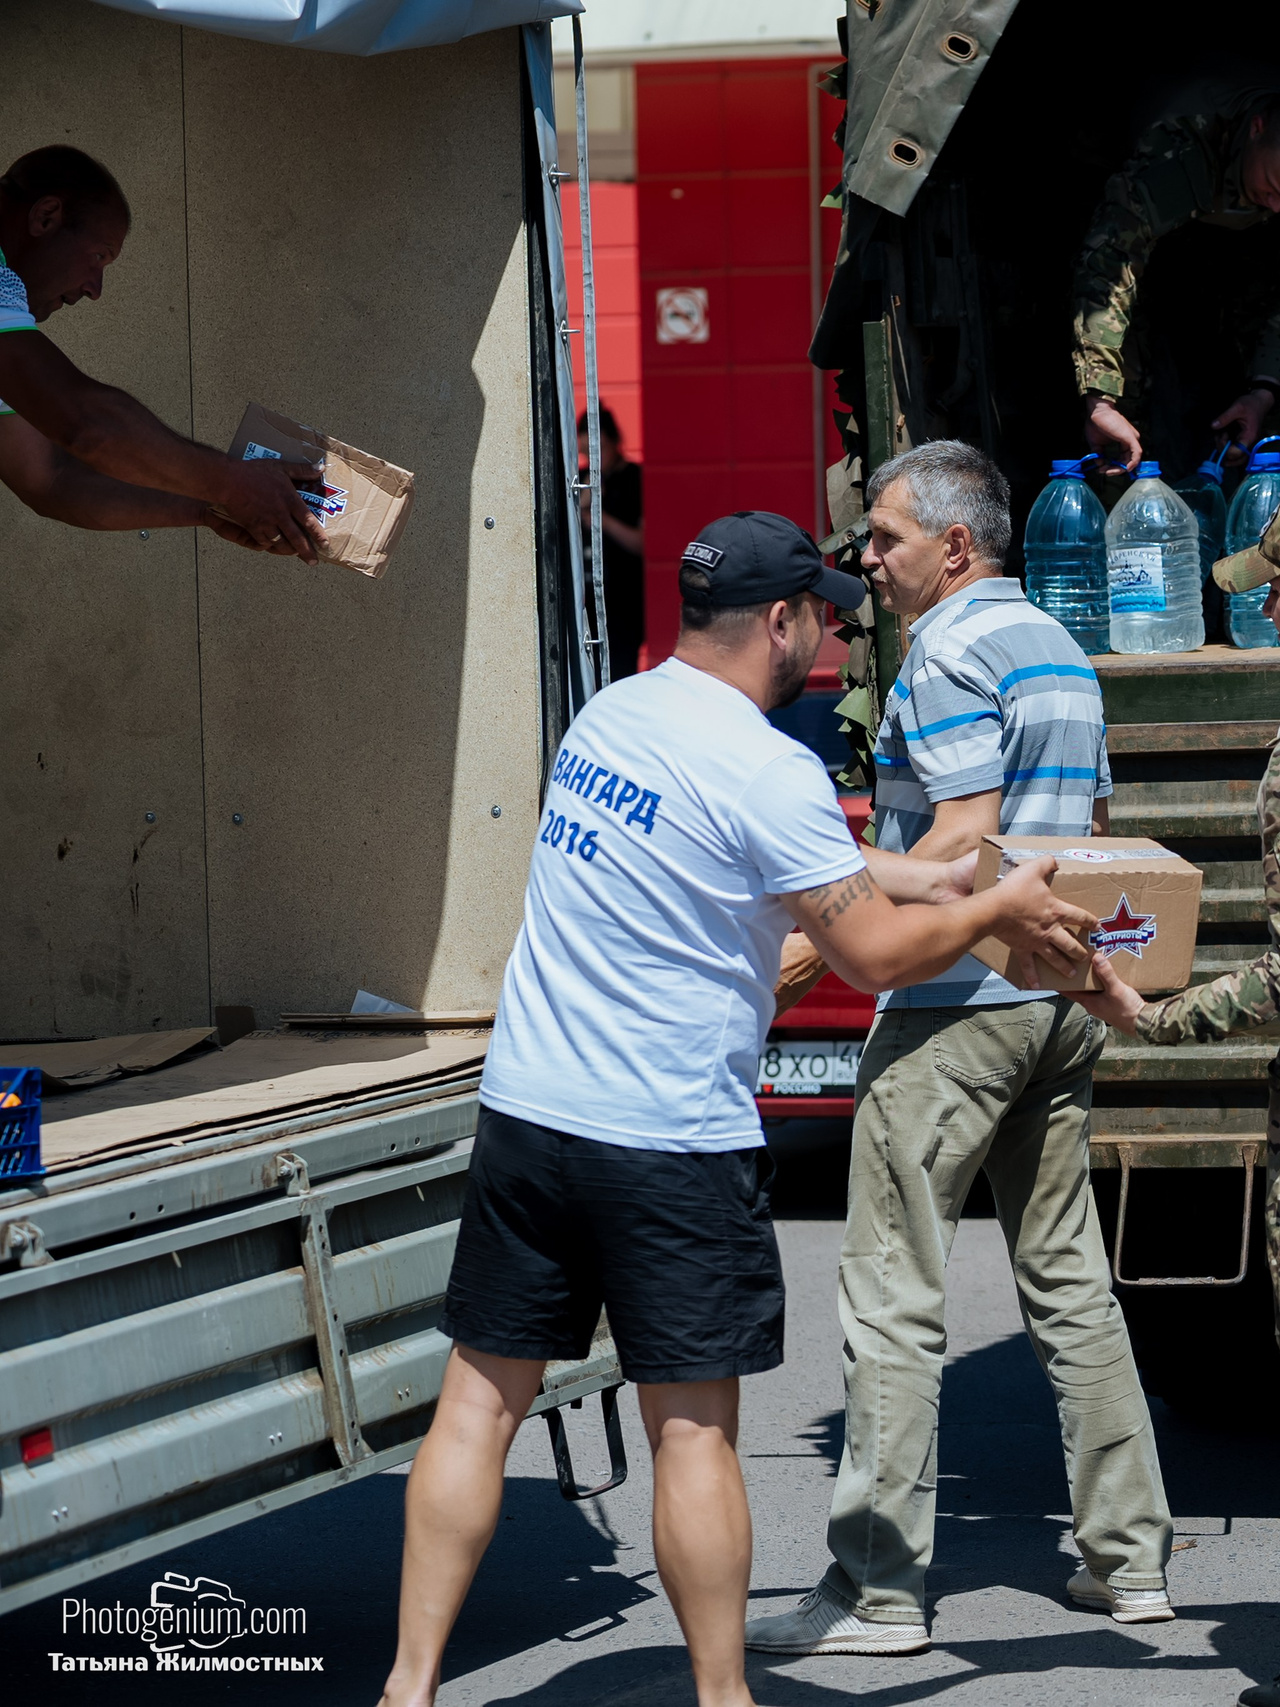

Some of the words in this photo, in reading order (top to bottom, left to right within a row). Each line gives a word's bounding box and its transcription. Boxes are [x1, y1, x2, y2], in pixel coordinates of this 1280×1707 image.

[300, 493, 330, 509] ТРИОТЫ
[552, 748, 662, 835] ВАНГАРД
[540, 809, 599, 862] 2016
[1102, 932, 1142, 943] ПАТРИОТЫ
[757, 1046, 828, 1078] 8ХО
